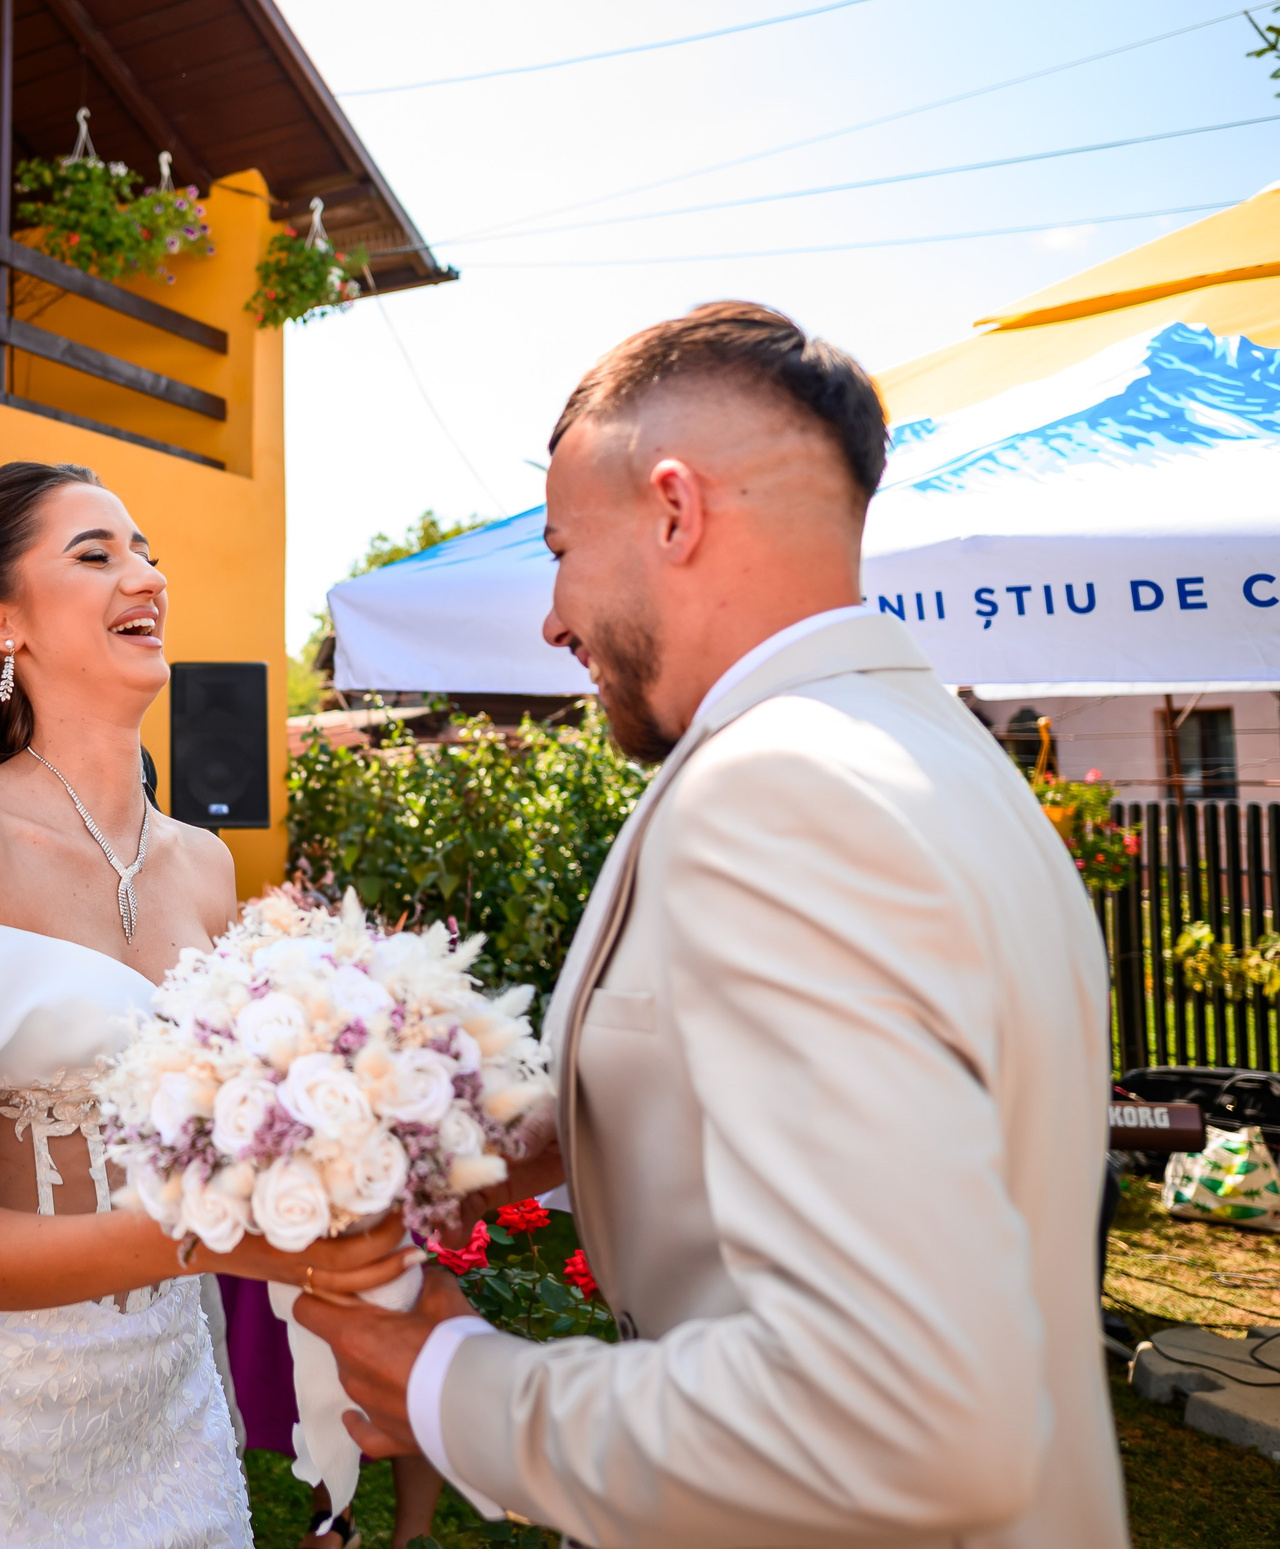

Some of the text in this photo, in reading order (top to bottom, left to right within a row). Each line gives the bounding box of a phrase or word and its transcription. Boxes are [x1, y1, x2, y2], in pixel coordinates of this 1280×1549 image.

[862, 591, 945, 621] NII
[975, 582, 1097, 630] ȘTIU
[1129, 576, 1208, 612] DE
[1108, 1105, 1170, 1128] KORG
